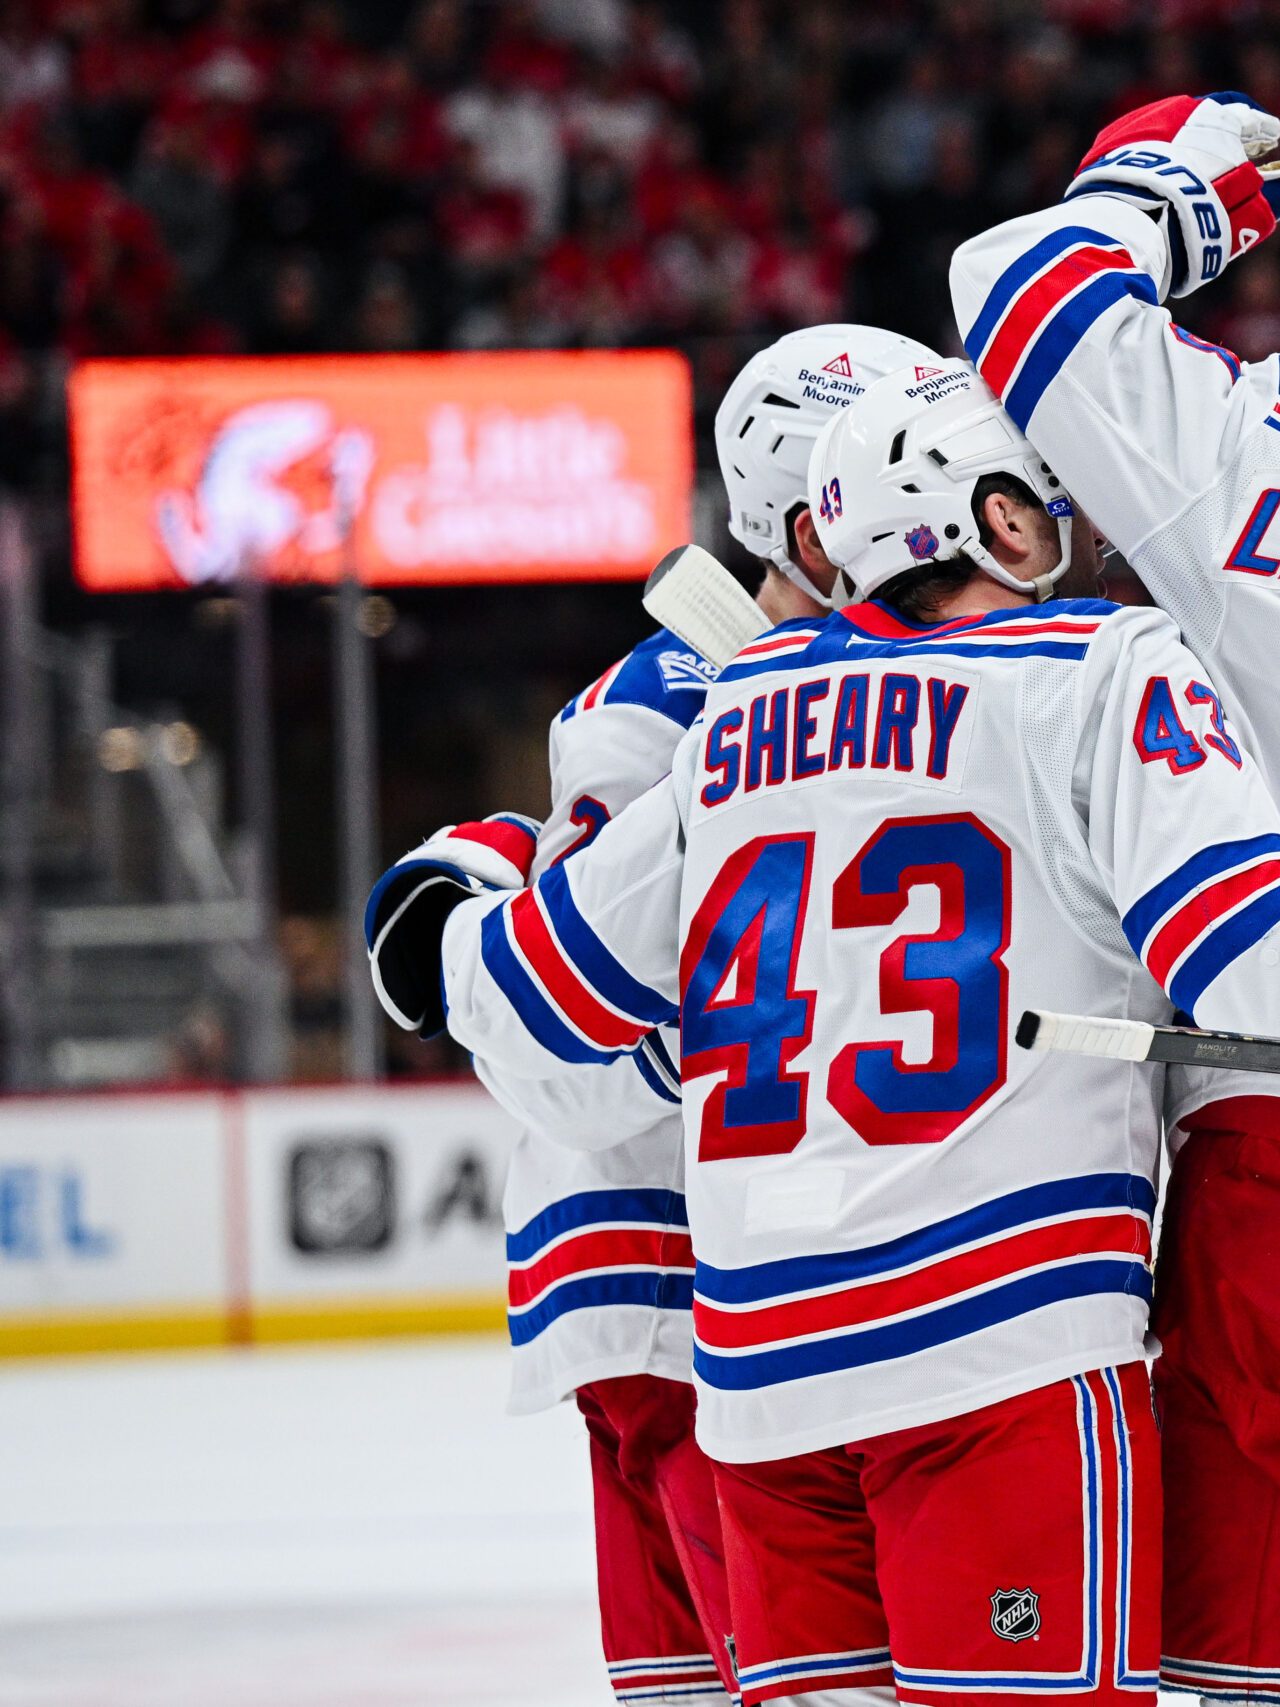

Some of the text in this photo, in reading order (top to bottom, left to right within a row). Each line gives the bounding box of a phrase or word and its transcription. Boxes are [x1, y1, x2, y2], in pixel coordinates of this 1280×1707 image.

[798, 369, 866, 397] Benjamin
[802, 386, 852, 408] Moore
[905, 370, 971, 399] Benjamin
[819, 476, 843, 526] 43
[700, 672, 970, 809] SHEARY
[1132, 676, 1244, 777] 43
[679, 811, 1013, 1163] 43
[1001, 1601, 1030, 1631] NHL
